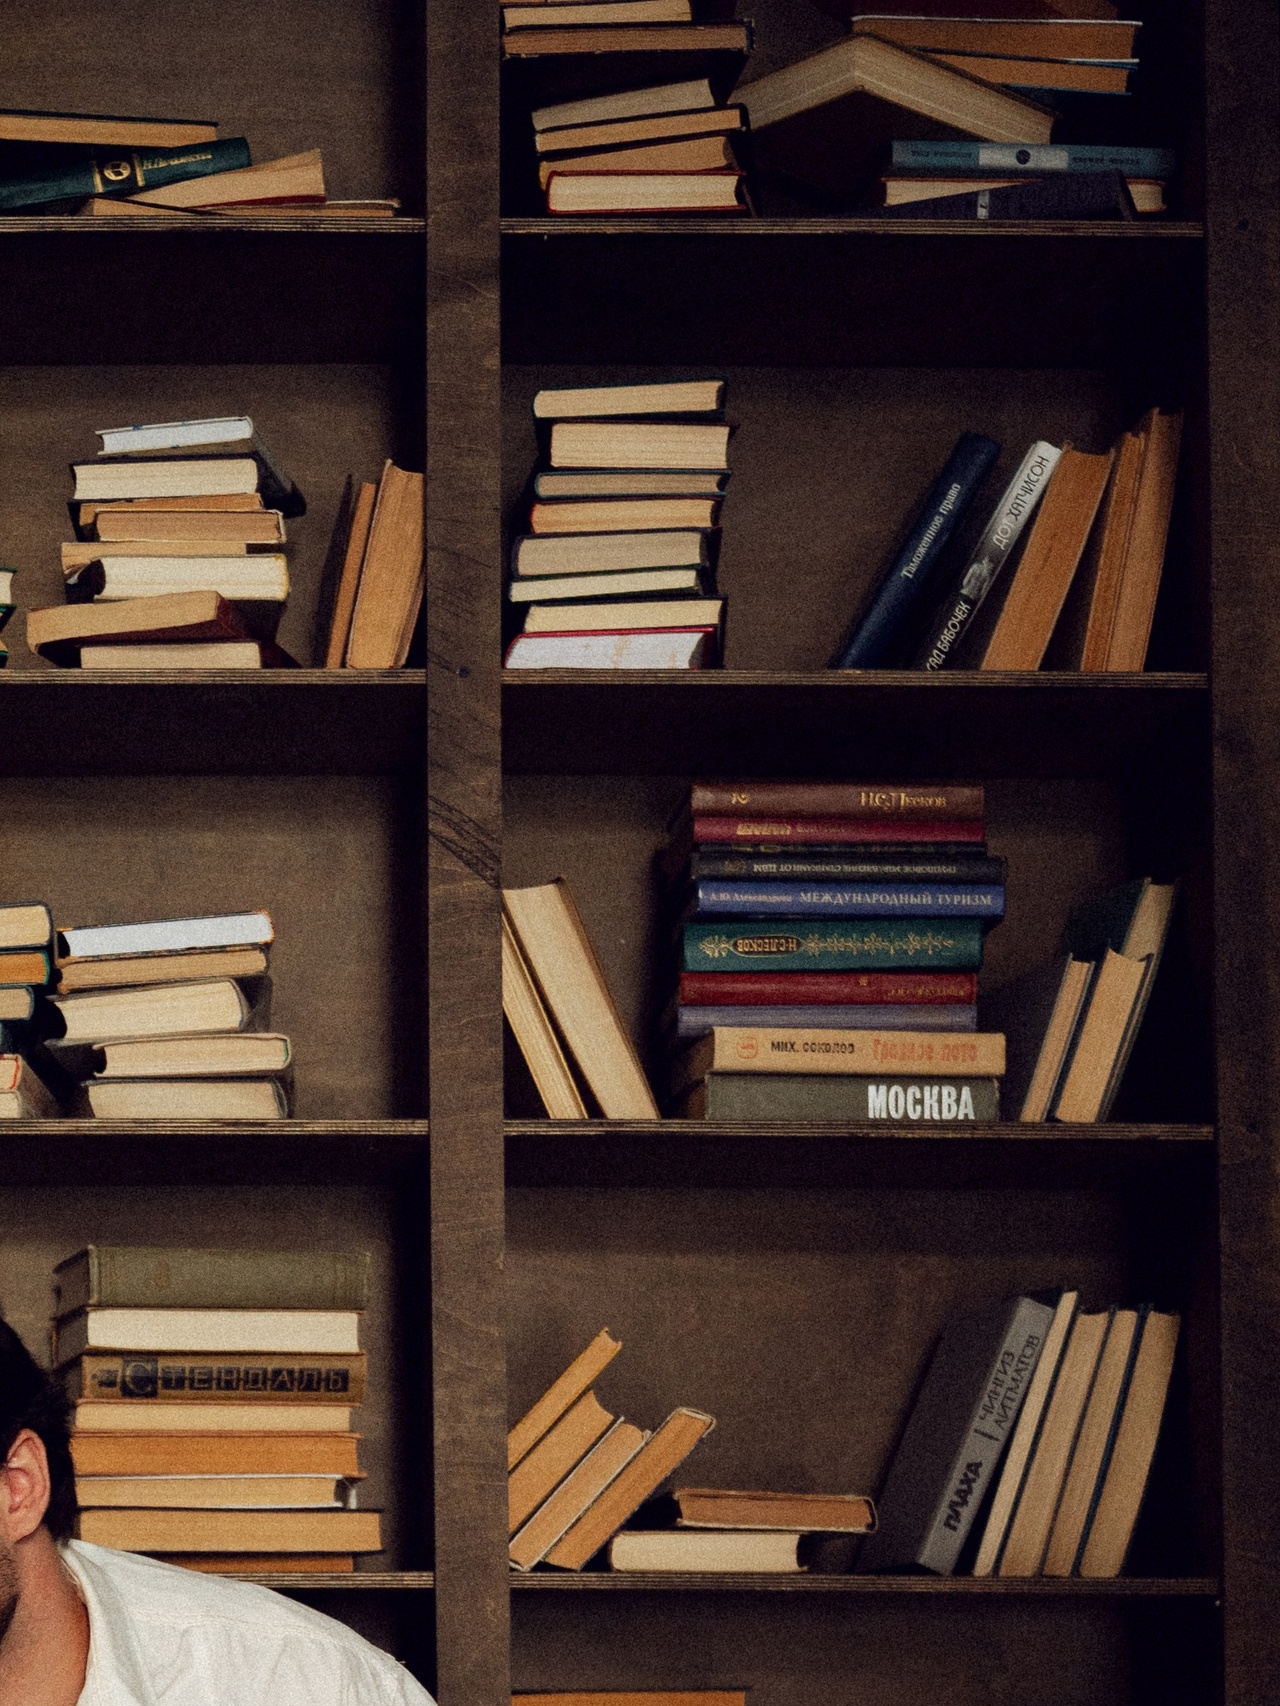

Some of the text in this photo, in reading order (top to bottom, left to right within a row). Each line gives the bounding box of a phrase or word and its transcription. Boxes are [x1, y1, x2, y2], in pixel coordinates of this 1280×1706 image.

[1008, 455, 1050, 521] ХАТЧИСОН
[901, 482, 962, 580] Таможенное право
[937, 601, 971, 652] БАБОЧЕК
[799, 889, 993, 908] МЕЖДУНАРОДНЫЙ ТУРИЗМ
[770, 1040, 856, 1055] МИХ. СОКОЛОВ
[868, 1084, 976, 1121] МОСКВА
[123, 1360, 349, 1396] СТЕНДАЛЬ
[978, 1350, 1016, 1422] ЧИНГИЗ
[943, 1461, 983, 1532] ПЛАХА
